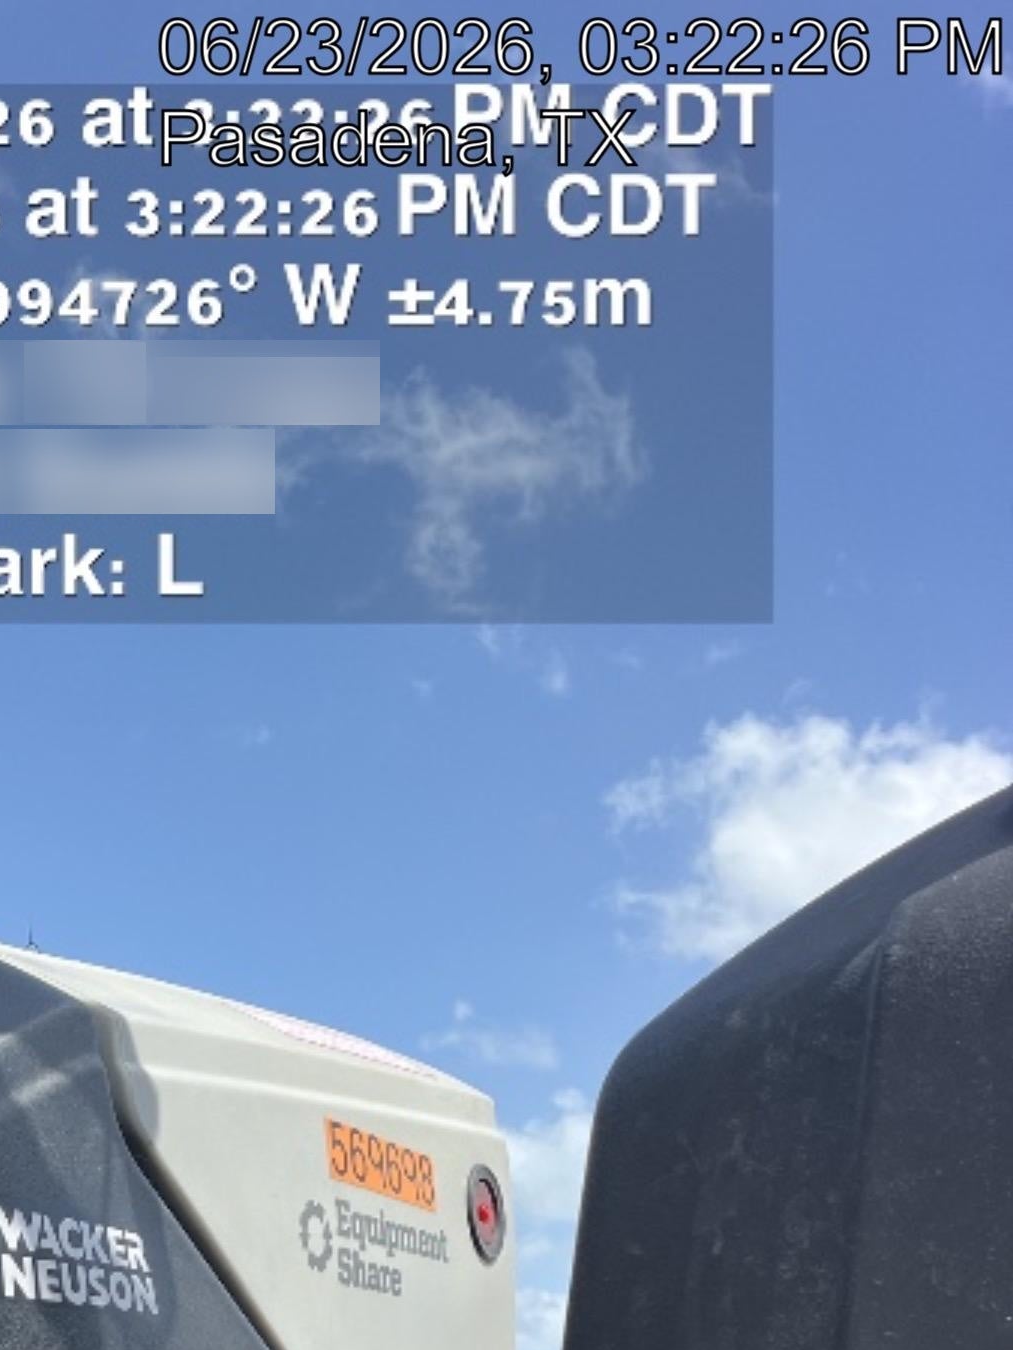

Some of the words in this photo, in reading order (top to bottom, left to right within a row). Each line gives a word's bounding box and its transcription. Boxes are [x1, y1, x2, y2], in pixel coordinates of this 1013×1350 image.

[329, 1120, 434, 1208] 569698
[334, 1198, 450, 1264] Equipment
[0, 1252, 159, 1315] NEUSON
[336, 1248, 403, 1297] Share
